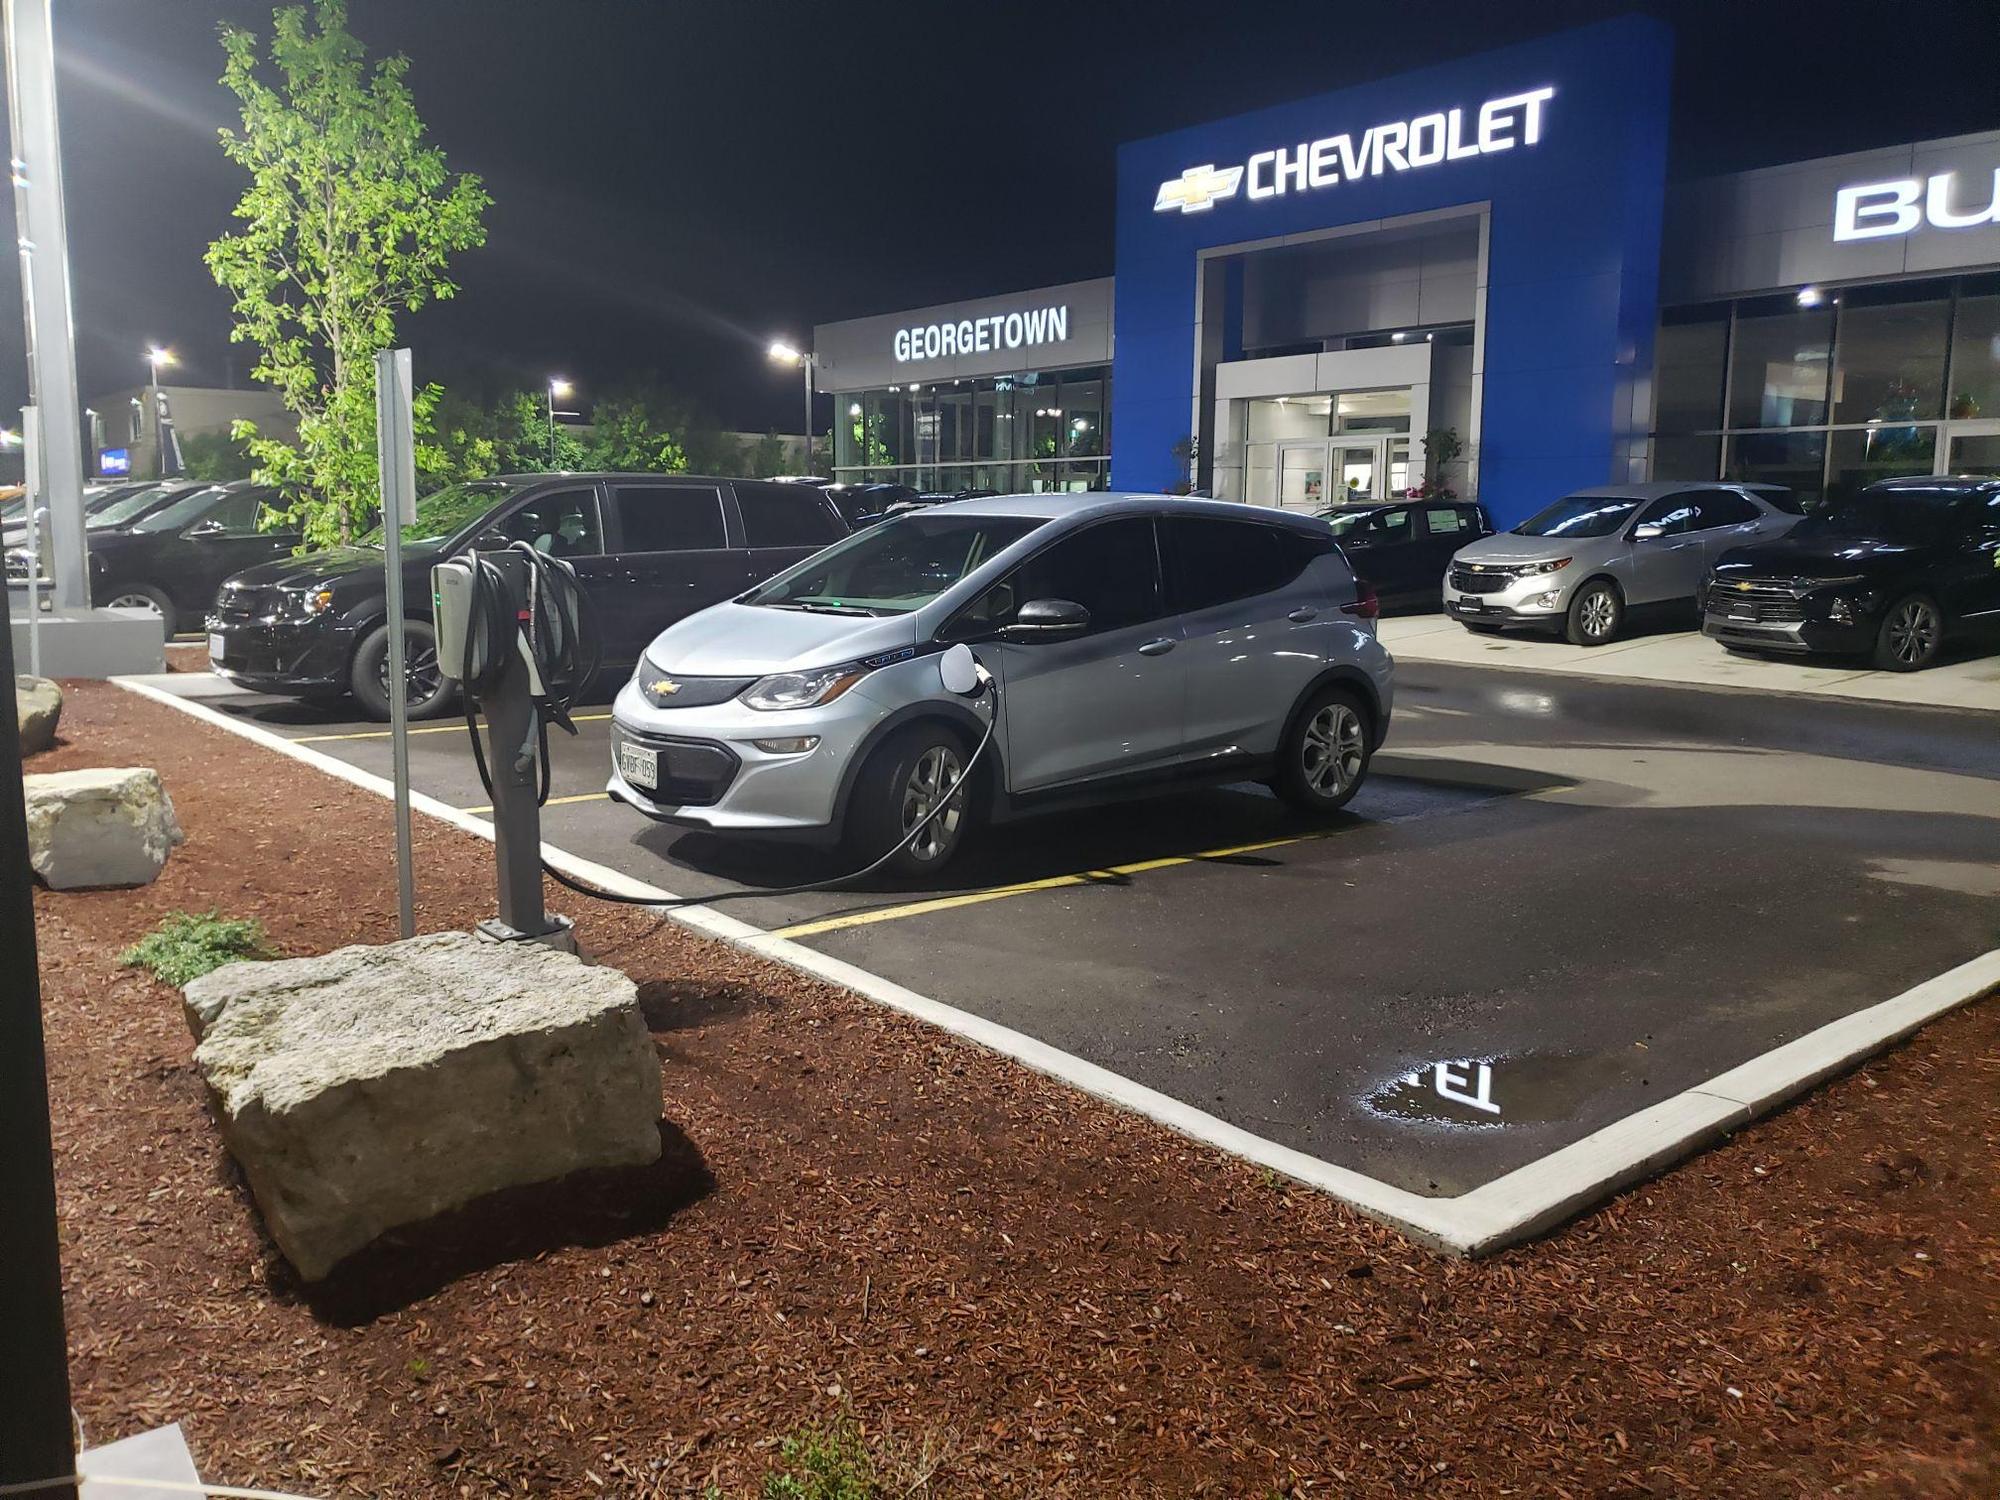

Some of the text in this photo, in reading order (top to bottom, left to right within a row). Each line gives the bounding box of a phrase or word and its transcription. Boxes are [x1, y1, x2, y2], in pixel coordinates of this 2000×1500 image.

[1247, 87, 1554, 201] CHEVROLET
[1833, 168, 2000, 242] BU
[894, 305, 1067, 362] GEORGETOWN
